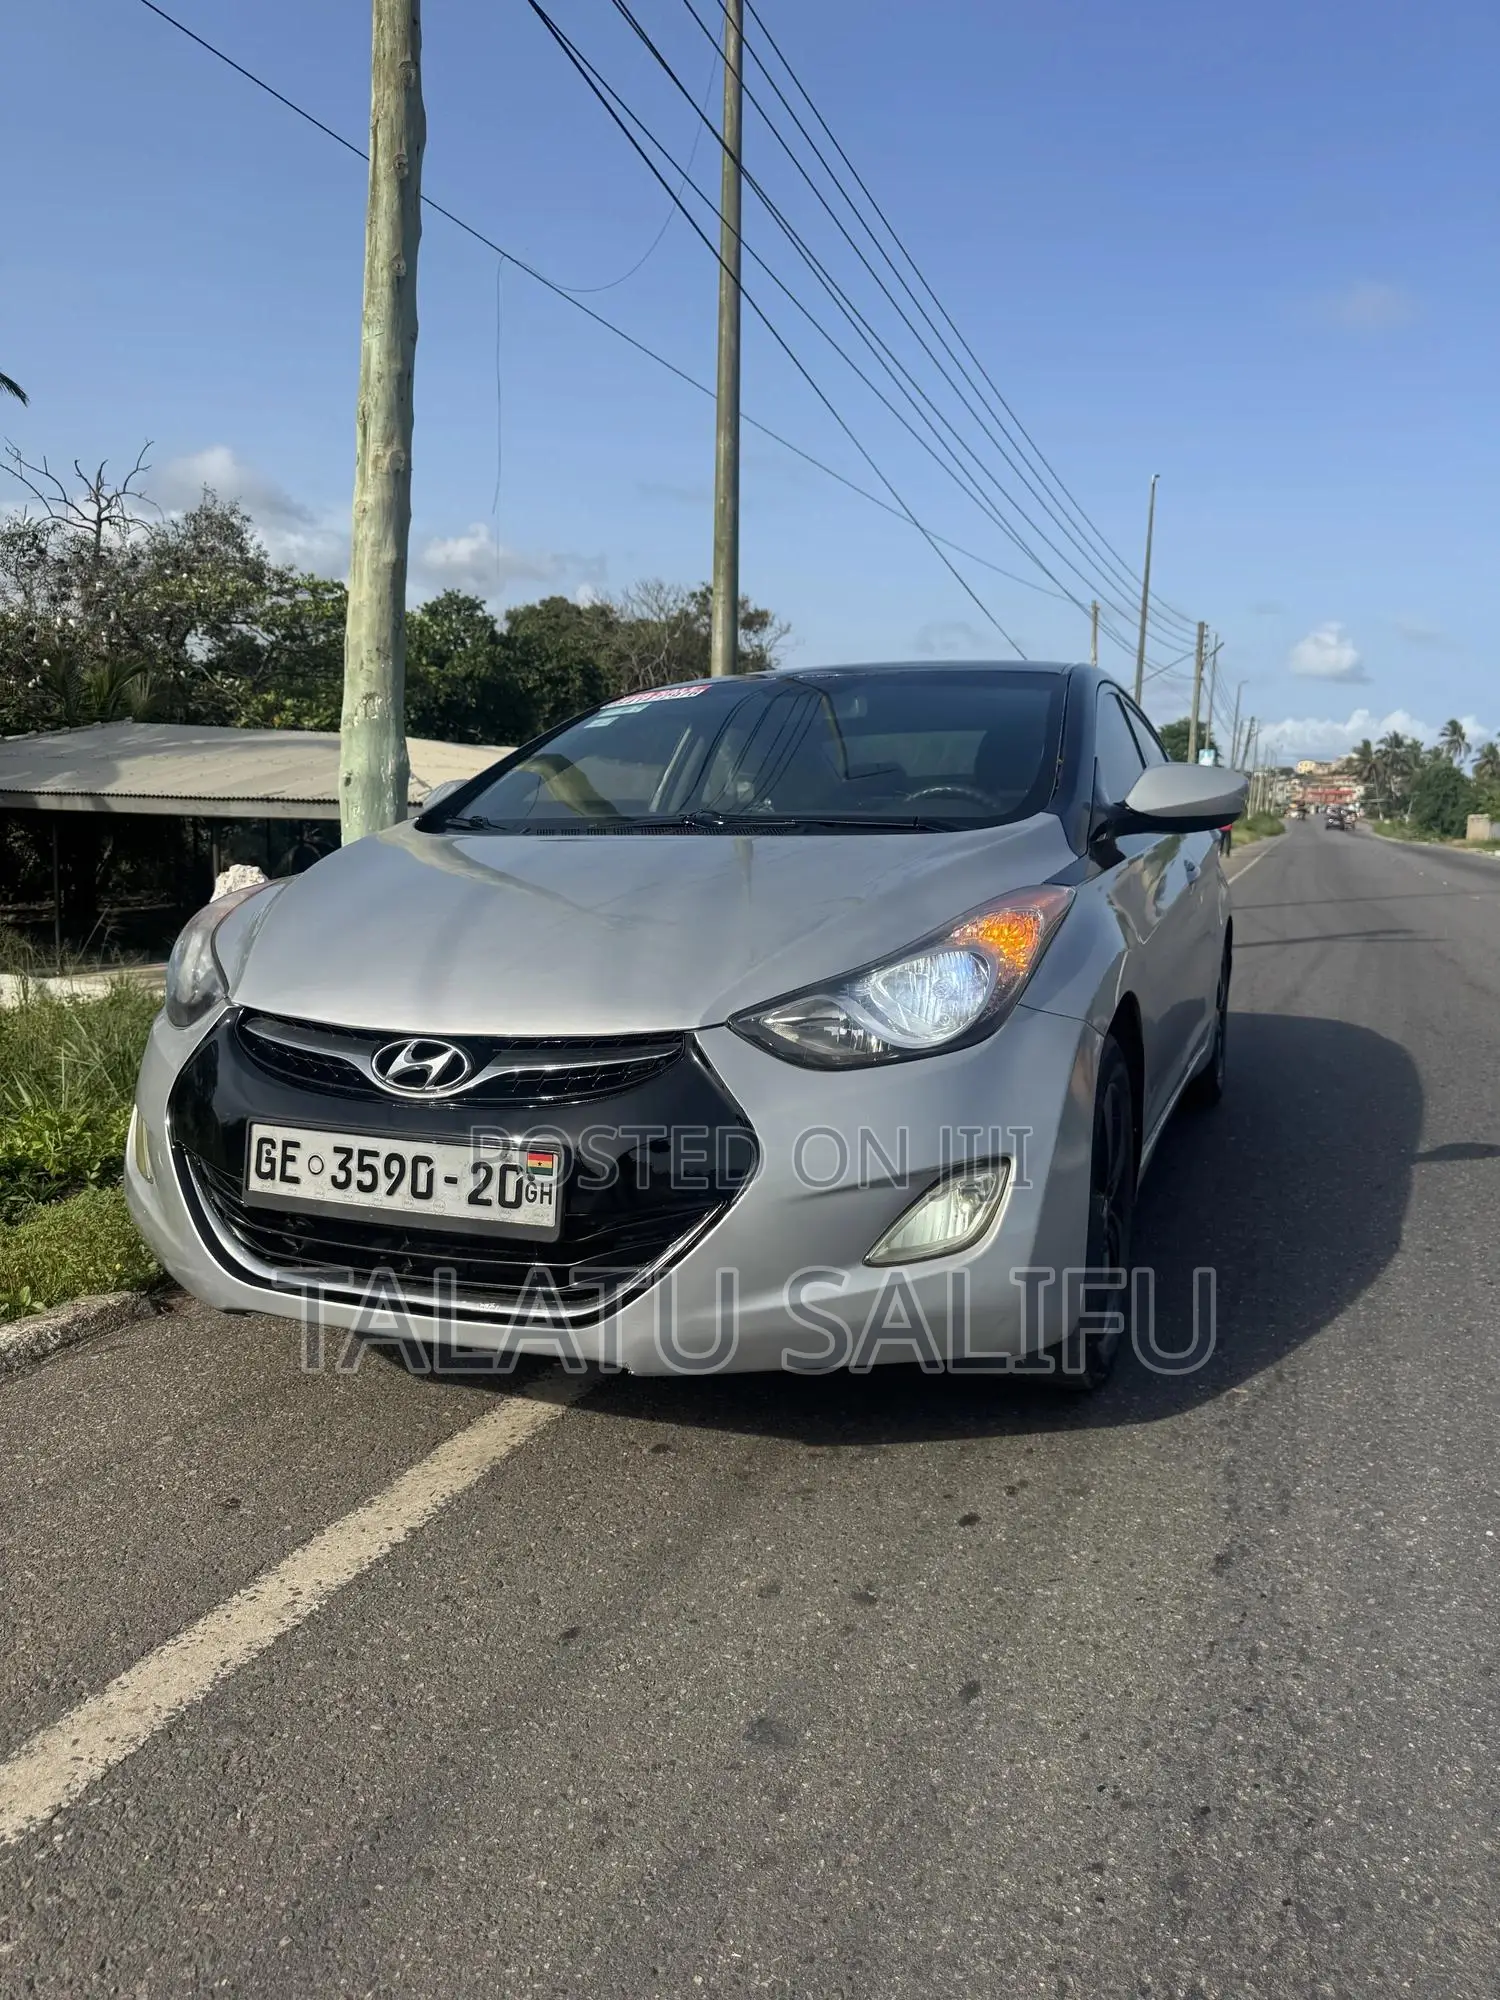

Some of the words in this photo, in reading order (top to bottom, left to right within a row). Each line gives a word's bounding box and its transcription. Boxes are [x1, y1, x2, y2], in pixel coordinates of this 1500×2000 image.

[255, 1137, 301, 1185] GE
[330, 1146, 524, 1210] 3590-20
[524, 1180, 553, 1206] GH
